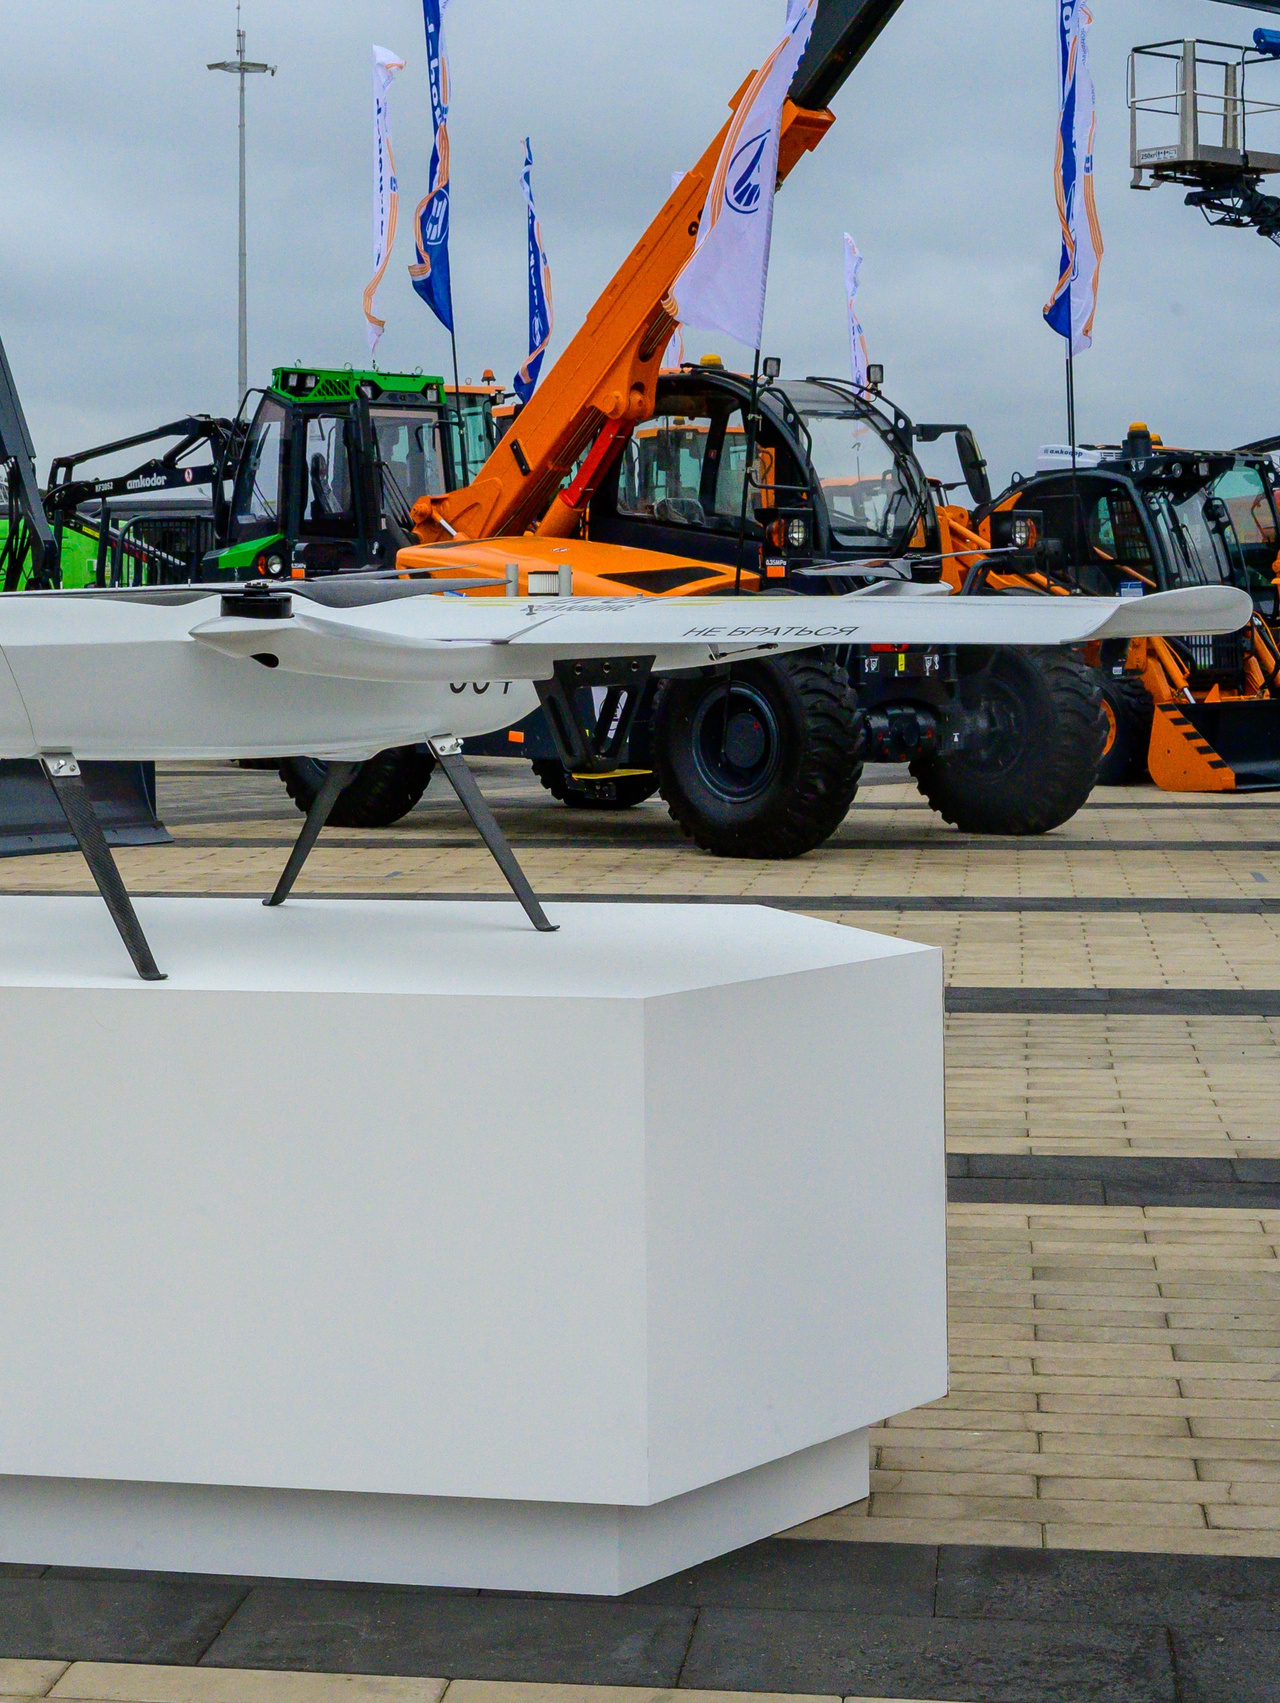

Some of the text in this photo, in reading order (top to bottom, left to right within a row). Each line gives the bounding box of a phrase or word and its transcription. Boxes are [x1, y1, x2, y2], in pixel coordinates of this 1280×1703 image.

[95, 481, 114, 493] KF3052
[126, 472, 168, 490] amkodor
[682, 626, 860, 637] НЕ БРАТЬСЯ
